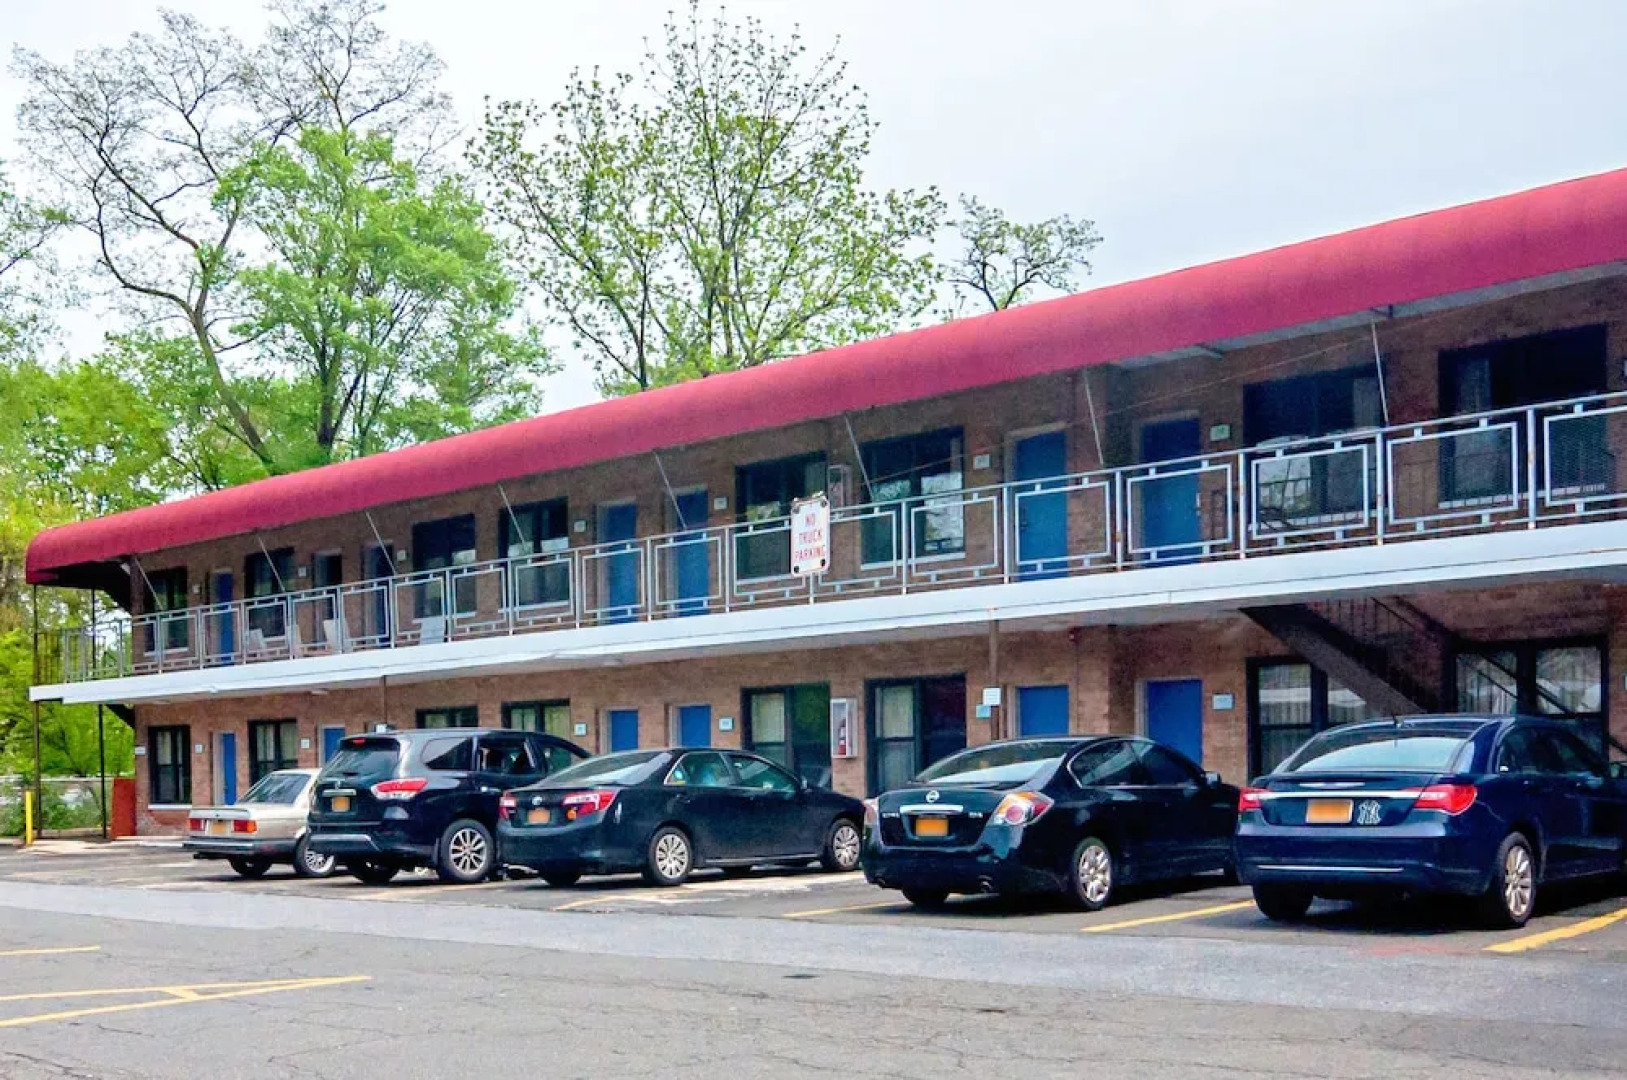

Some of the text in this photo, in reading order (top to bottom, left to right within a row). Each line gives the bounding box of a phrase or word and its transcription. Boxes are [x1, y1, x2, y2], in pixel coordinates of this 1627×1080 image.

[804, 513, 816, 527] NO
[798, 528, 823, 545] TRUCK
[794, 544, 826, 562] PARKING
